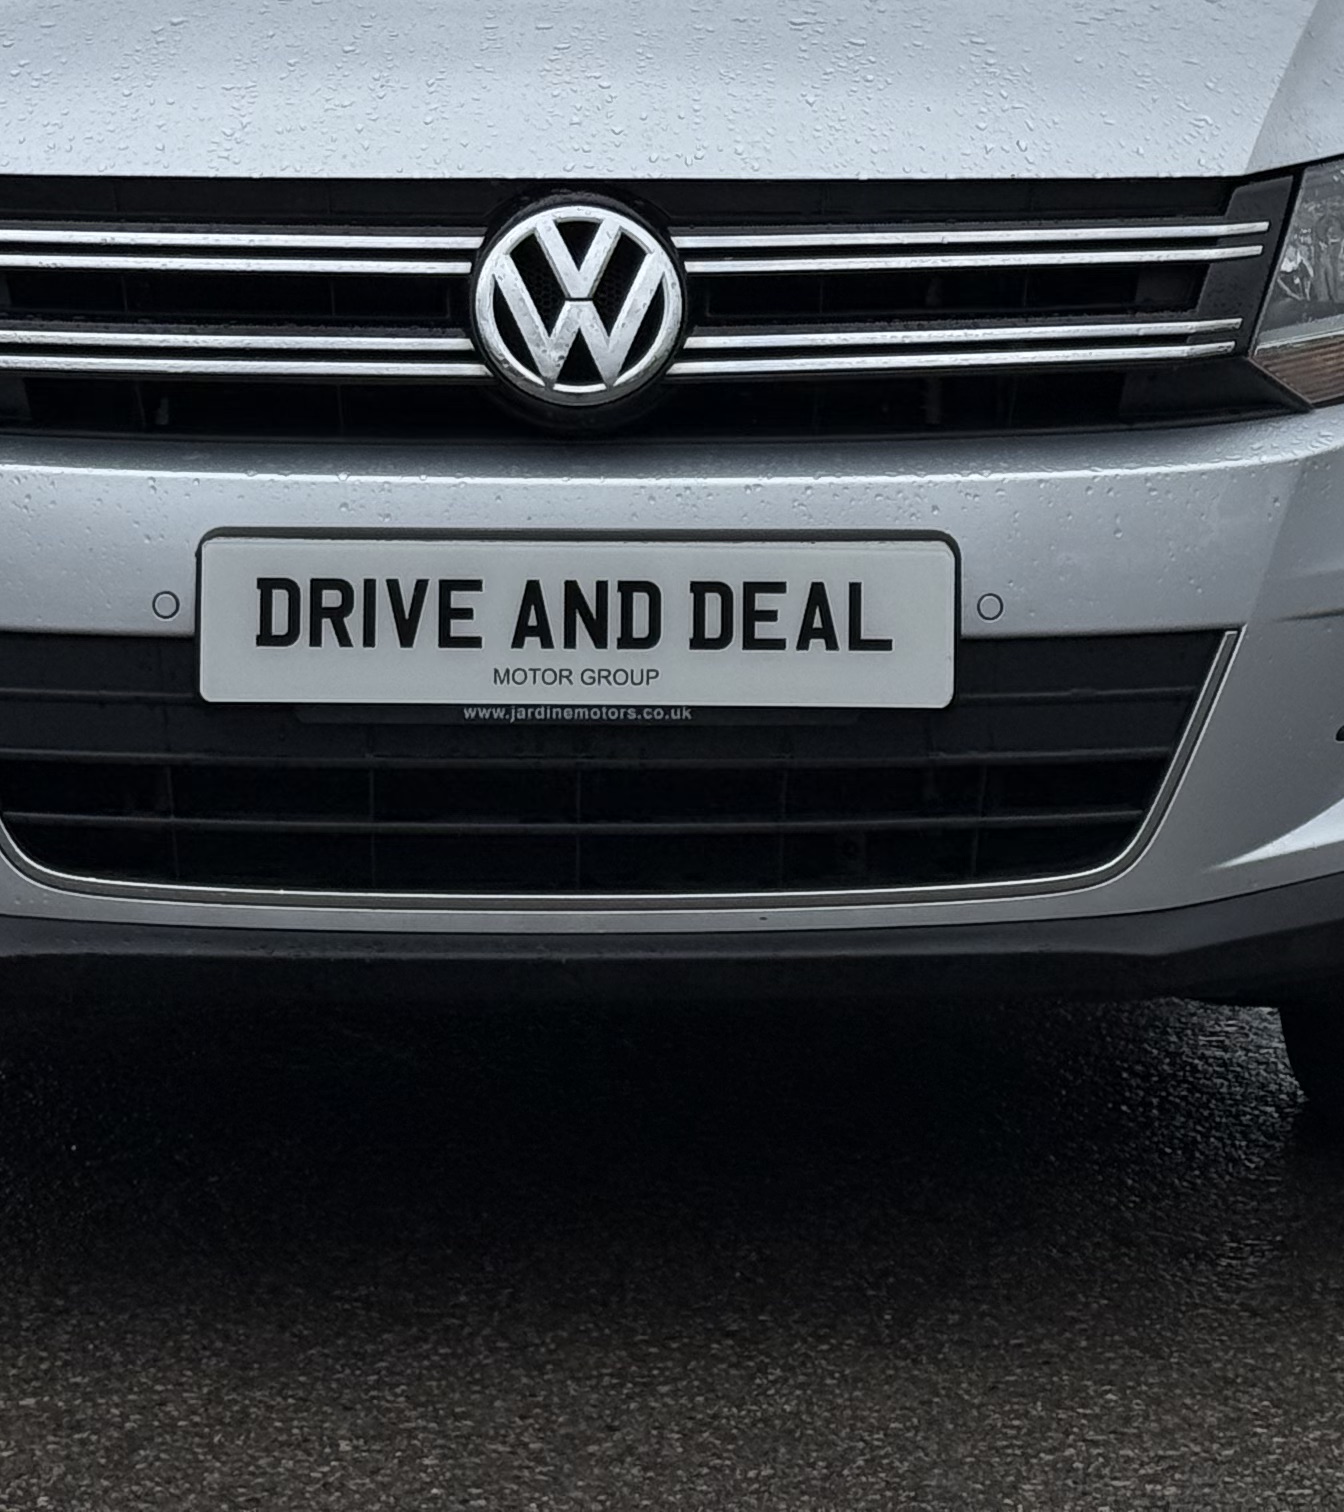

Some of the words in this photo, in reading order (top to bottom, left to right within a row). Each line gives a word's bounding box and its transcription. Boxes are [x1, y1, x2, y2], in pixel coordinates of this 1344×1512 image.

[255, 577, 484, 649] DRIVE
[511, 579, 663, 650] AND
[689, 581, 894, 652] DEAL
[493, 667, 574, 687] MOTOR
[580, 668, 660, 688] GROUP
[462, 704, 692, 723] www.jardinemotors.co.uk
